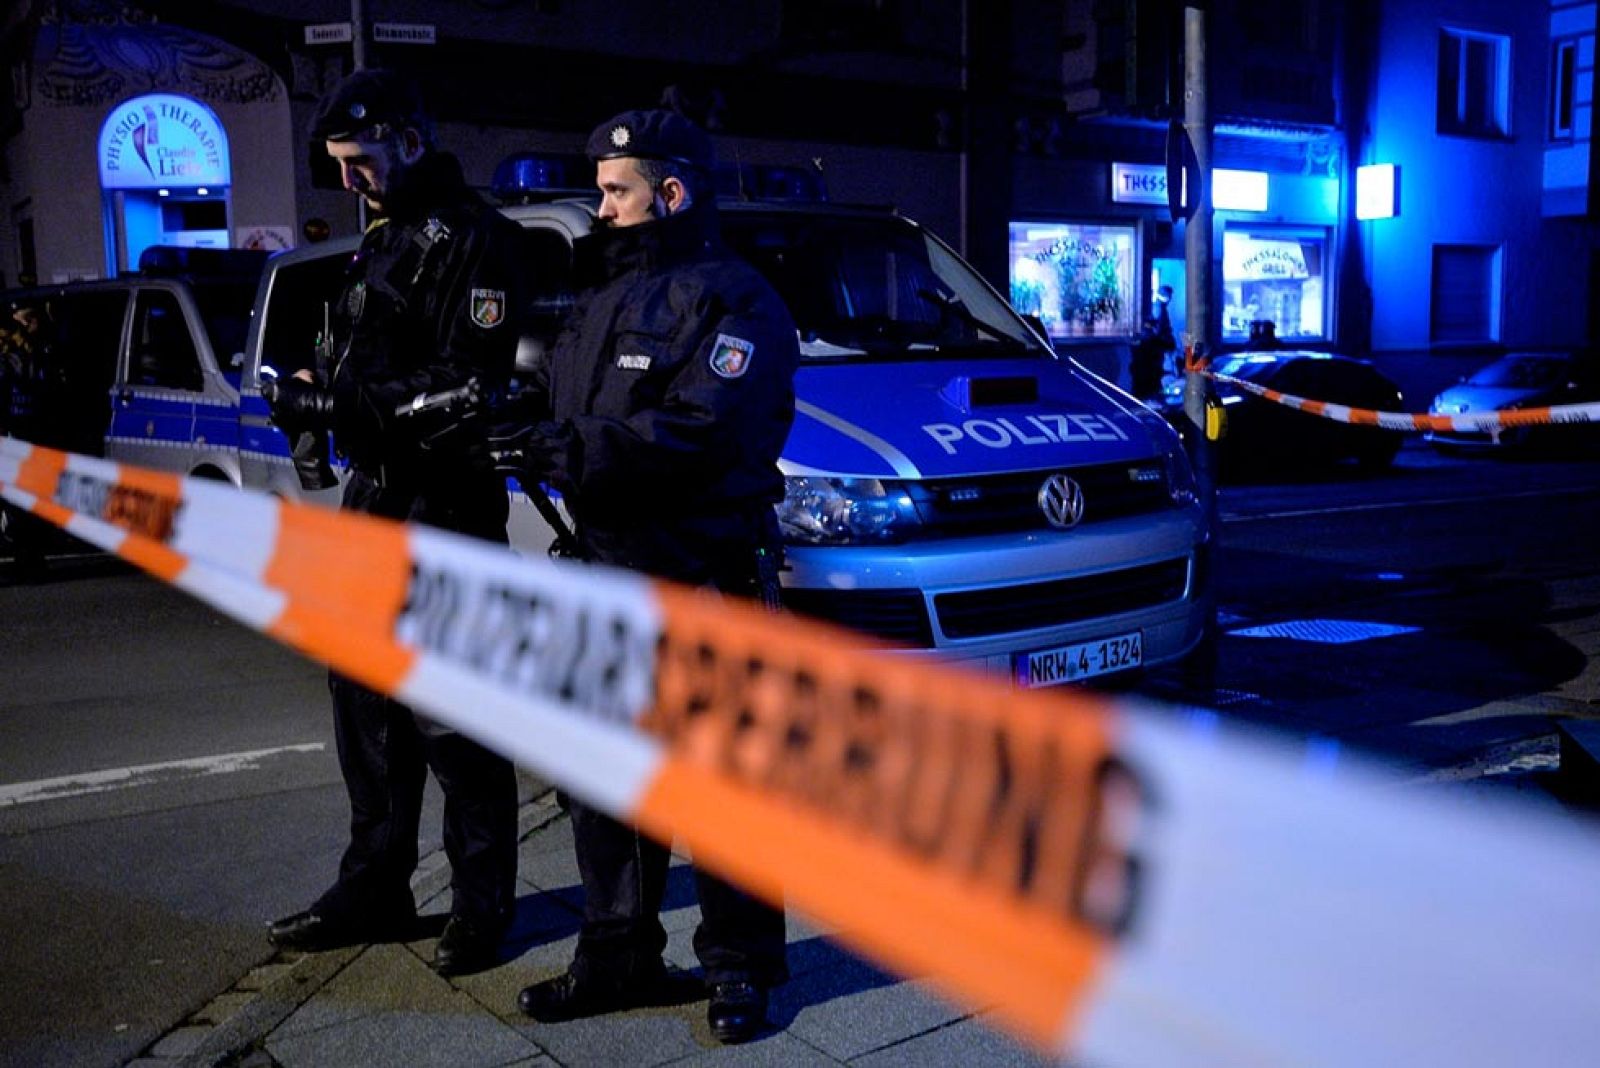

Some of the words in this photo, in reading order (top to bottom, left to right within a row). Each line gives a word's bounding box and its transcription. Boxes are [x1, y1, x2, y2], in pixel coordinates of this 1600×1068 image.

[107, 111, 140, 171] PHYSIO
[159, 103, 220, 169] THERAPIE
[1123, 173, 1167, 192] THESS
[921, 413, 1130, 456] POLIZEI
[1029, 651, 1068, 684] NRW
[1079, 636, 1140, 674] 4-1324
